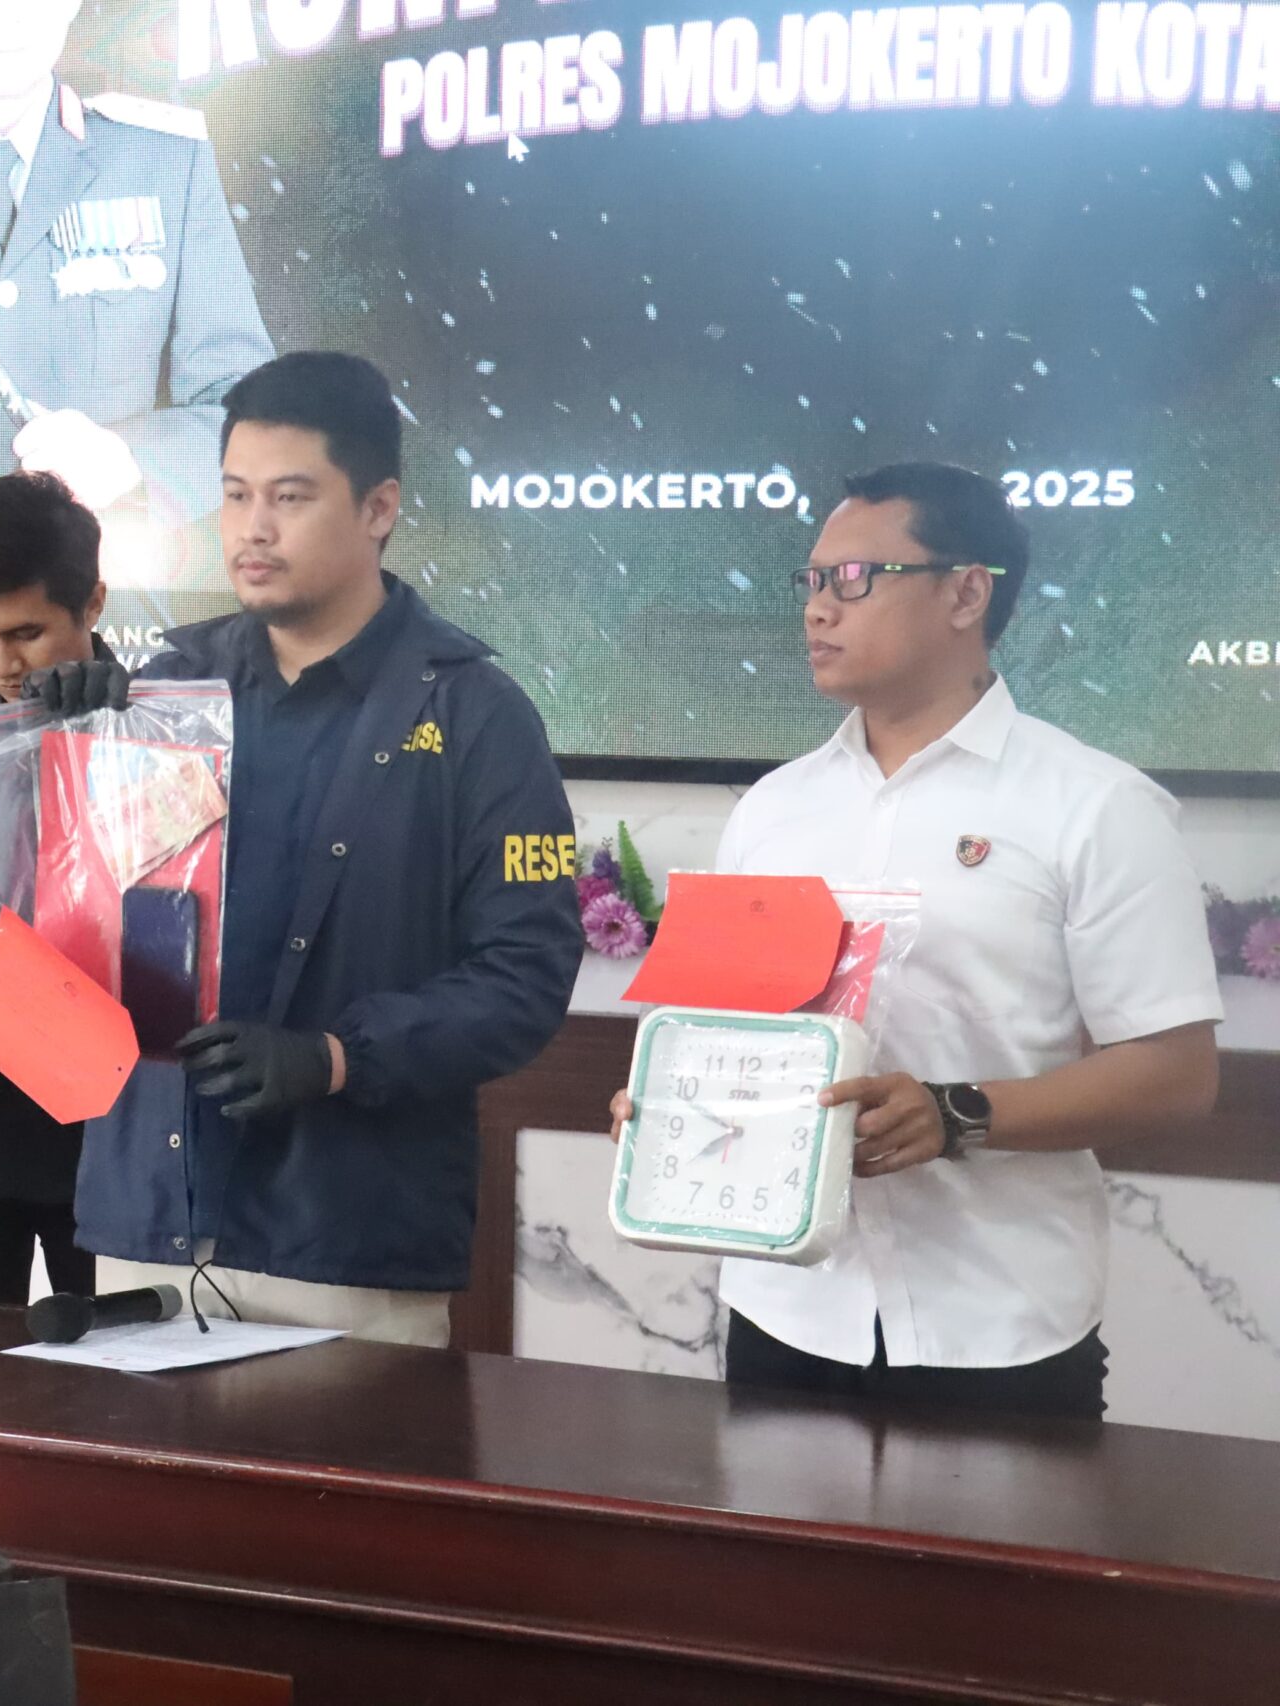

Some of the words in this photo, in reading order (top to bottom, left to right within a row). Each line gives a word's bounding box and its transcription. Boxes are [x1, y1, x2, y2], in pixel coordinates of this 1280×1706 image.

[379, 30, 623, 157] POLRES
[640, 3, 1073, 125] MOJOKERTO
[1092, 1, 1280, 111] KOTA
[470, 473, 811, 516] MOJOKERTO,
[1001, 469, 1135, 508] 2025
[705, 1054, 725, 1078] 11
[737, 1056, 762, 1081] 12
[675, 1075, 700, 1102] 10
[668, 1115, 685, 1140] 9
[791, 1127, 809, 1151] 3
[662, 1154, 679, 1179] 8
[784, 1167, 801, 1191] 4
[689, 1180, 704, 1205] 7
[719, 1185, 735, 1210] 6
[752, 1186, 769, 1212] 5
